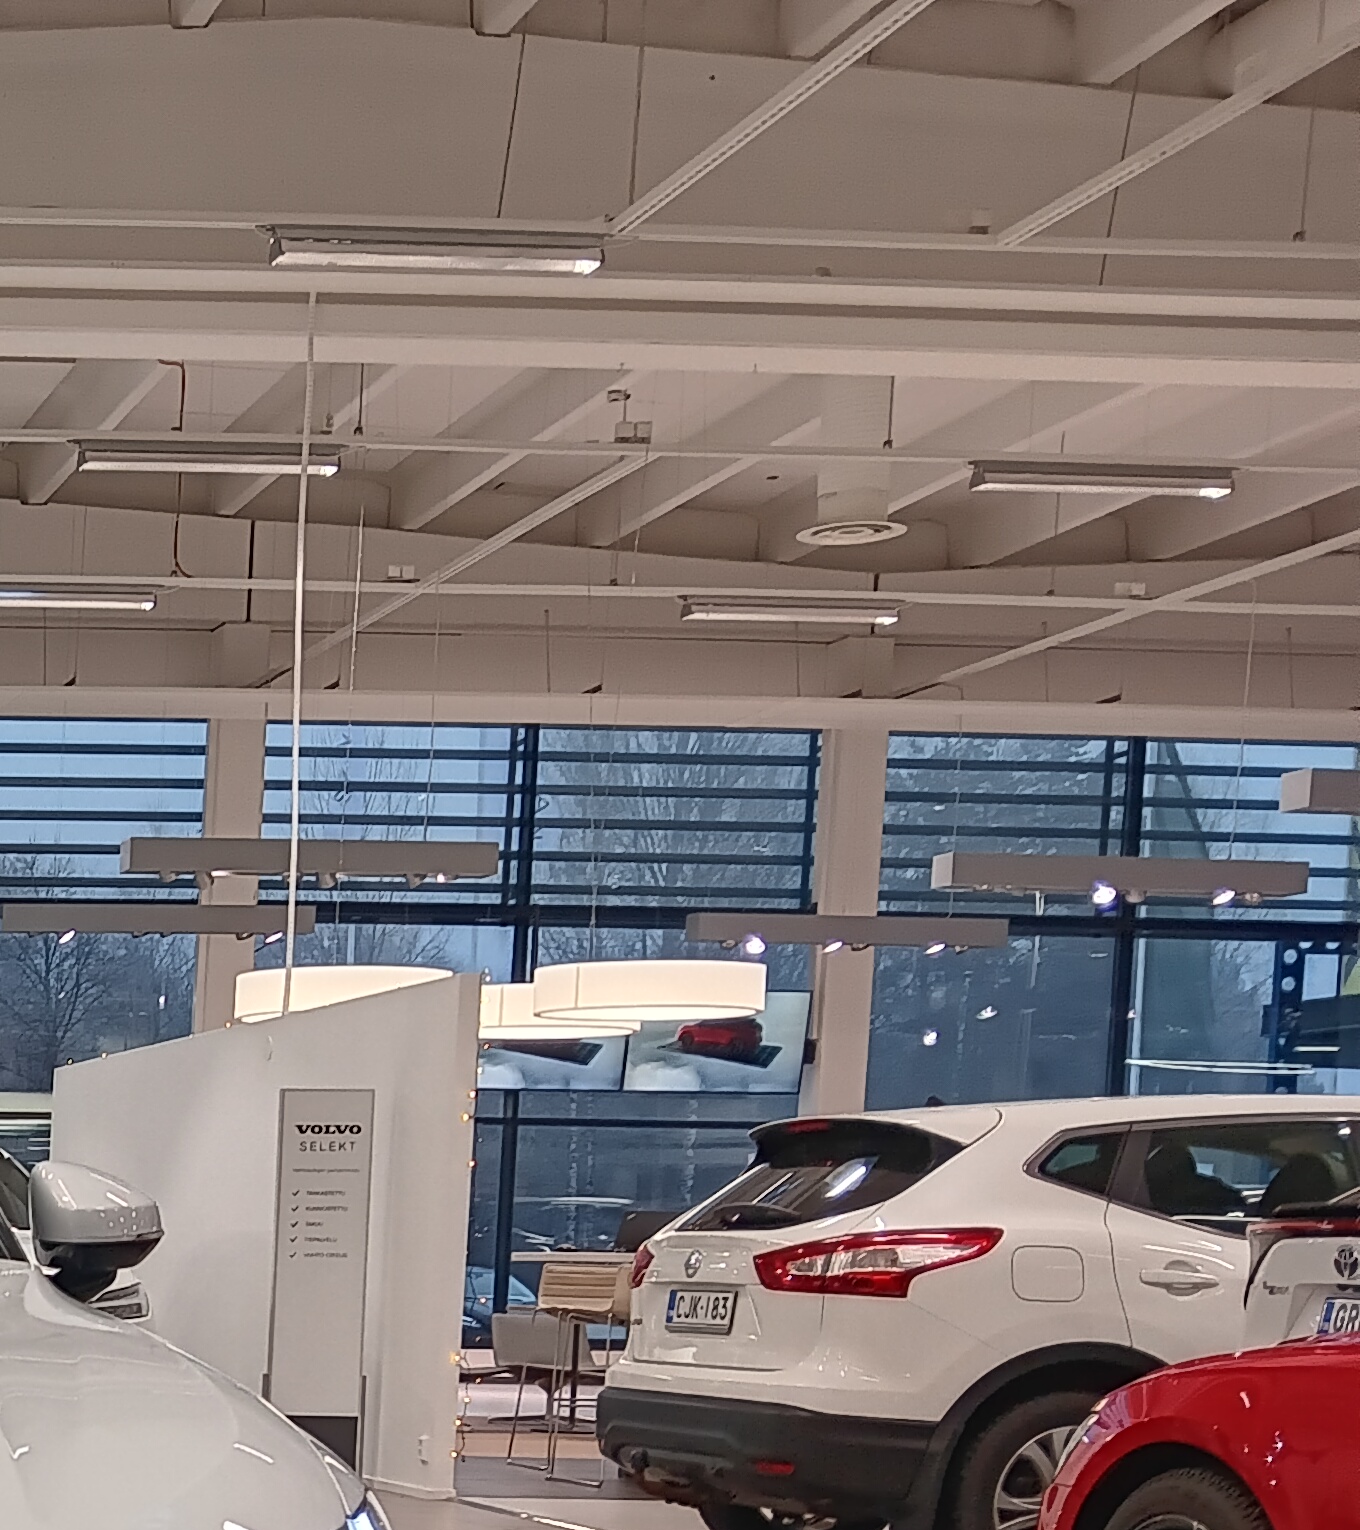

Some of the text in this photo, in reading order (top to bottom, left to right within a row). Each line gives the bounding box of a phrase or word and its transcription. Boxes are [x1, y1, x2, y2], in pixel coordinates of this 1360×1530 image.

[295, 1124, 362, 1135] VOLVO
[299, 1140, 356, 1152] SELEKT
[676, 1295, 730, 1321] CJK-183
[1334, 1303, 1360, 1333] GR
